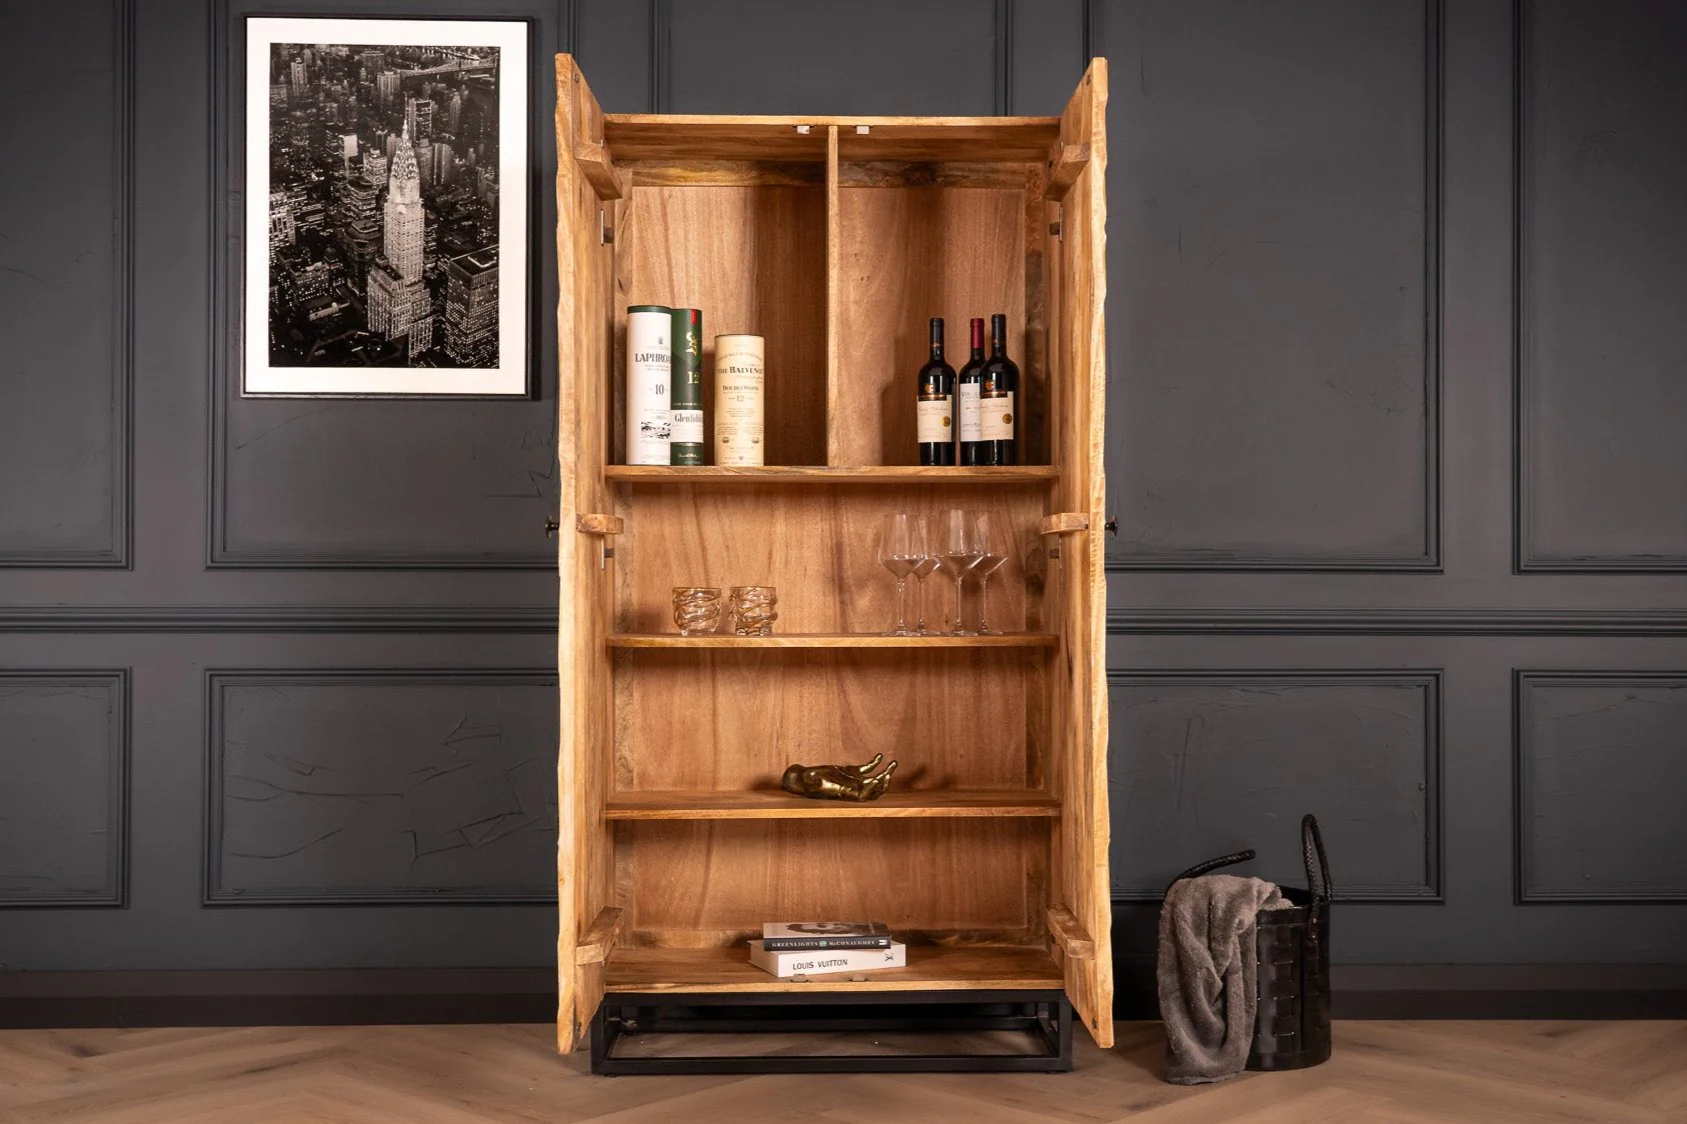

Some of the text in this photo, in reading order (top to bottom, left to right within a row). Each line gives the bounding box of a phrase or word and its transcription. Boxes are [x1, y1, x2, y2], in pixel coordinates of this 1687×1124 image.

[688, 371, 699, 384] 12
[655, 384, 664, 395] 10
[792, 959, 848, 970] LOUIS VUITTON
